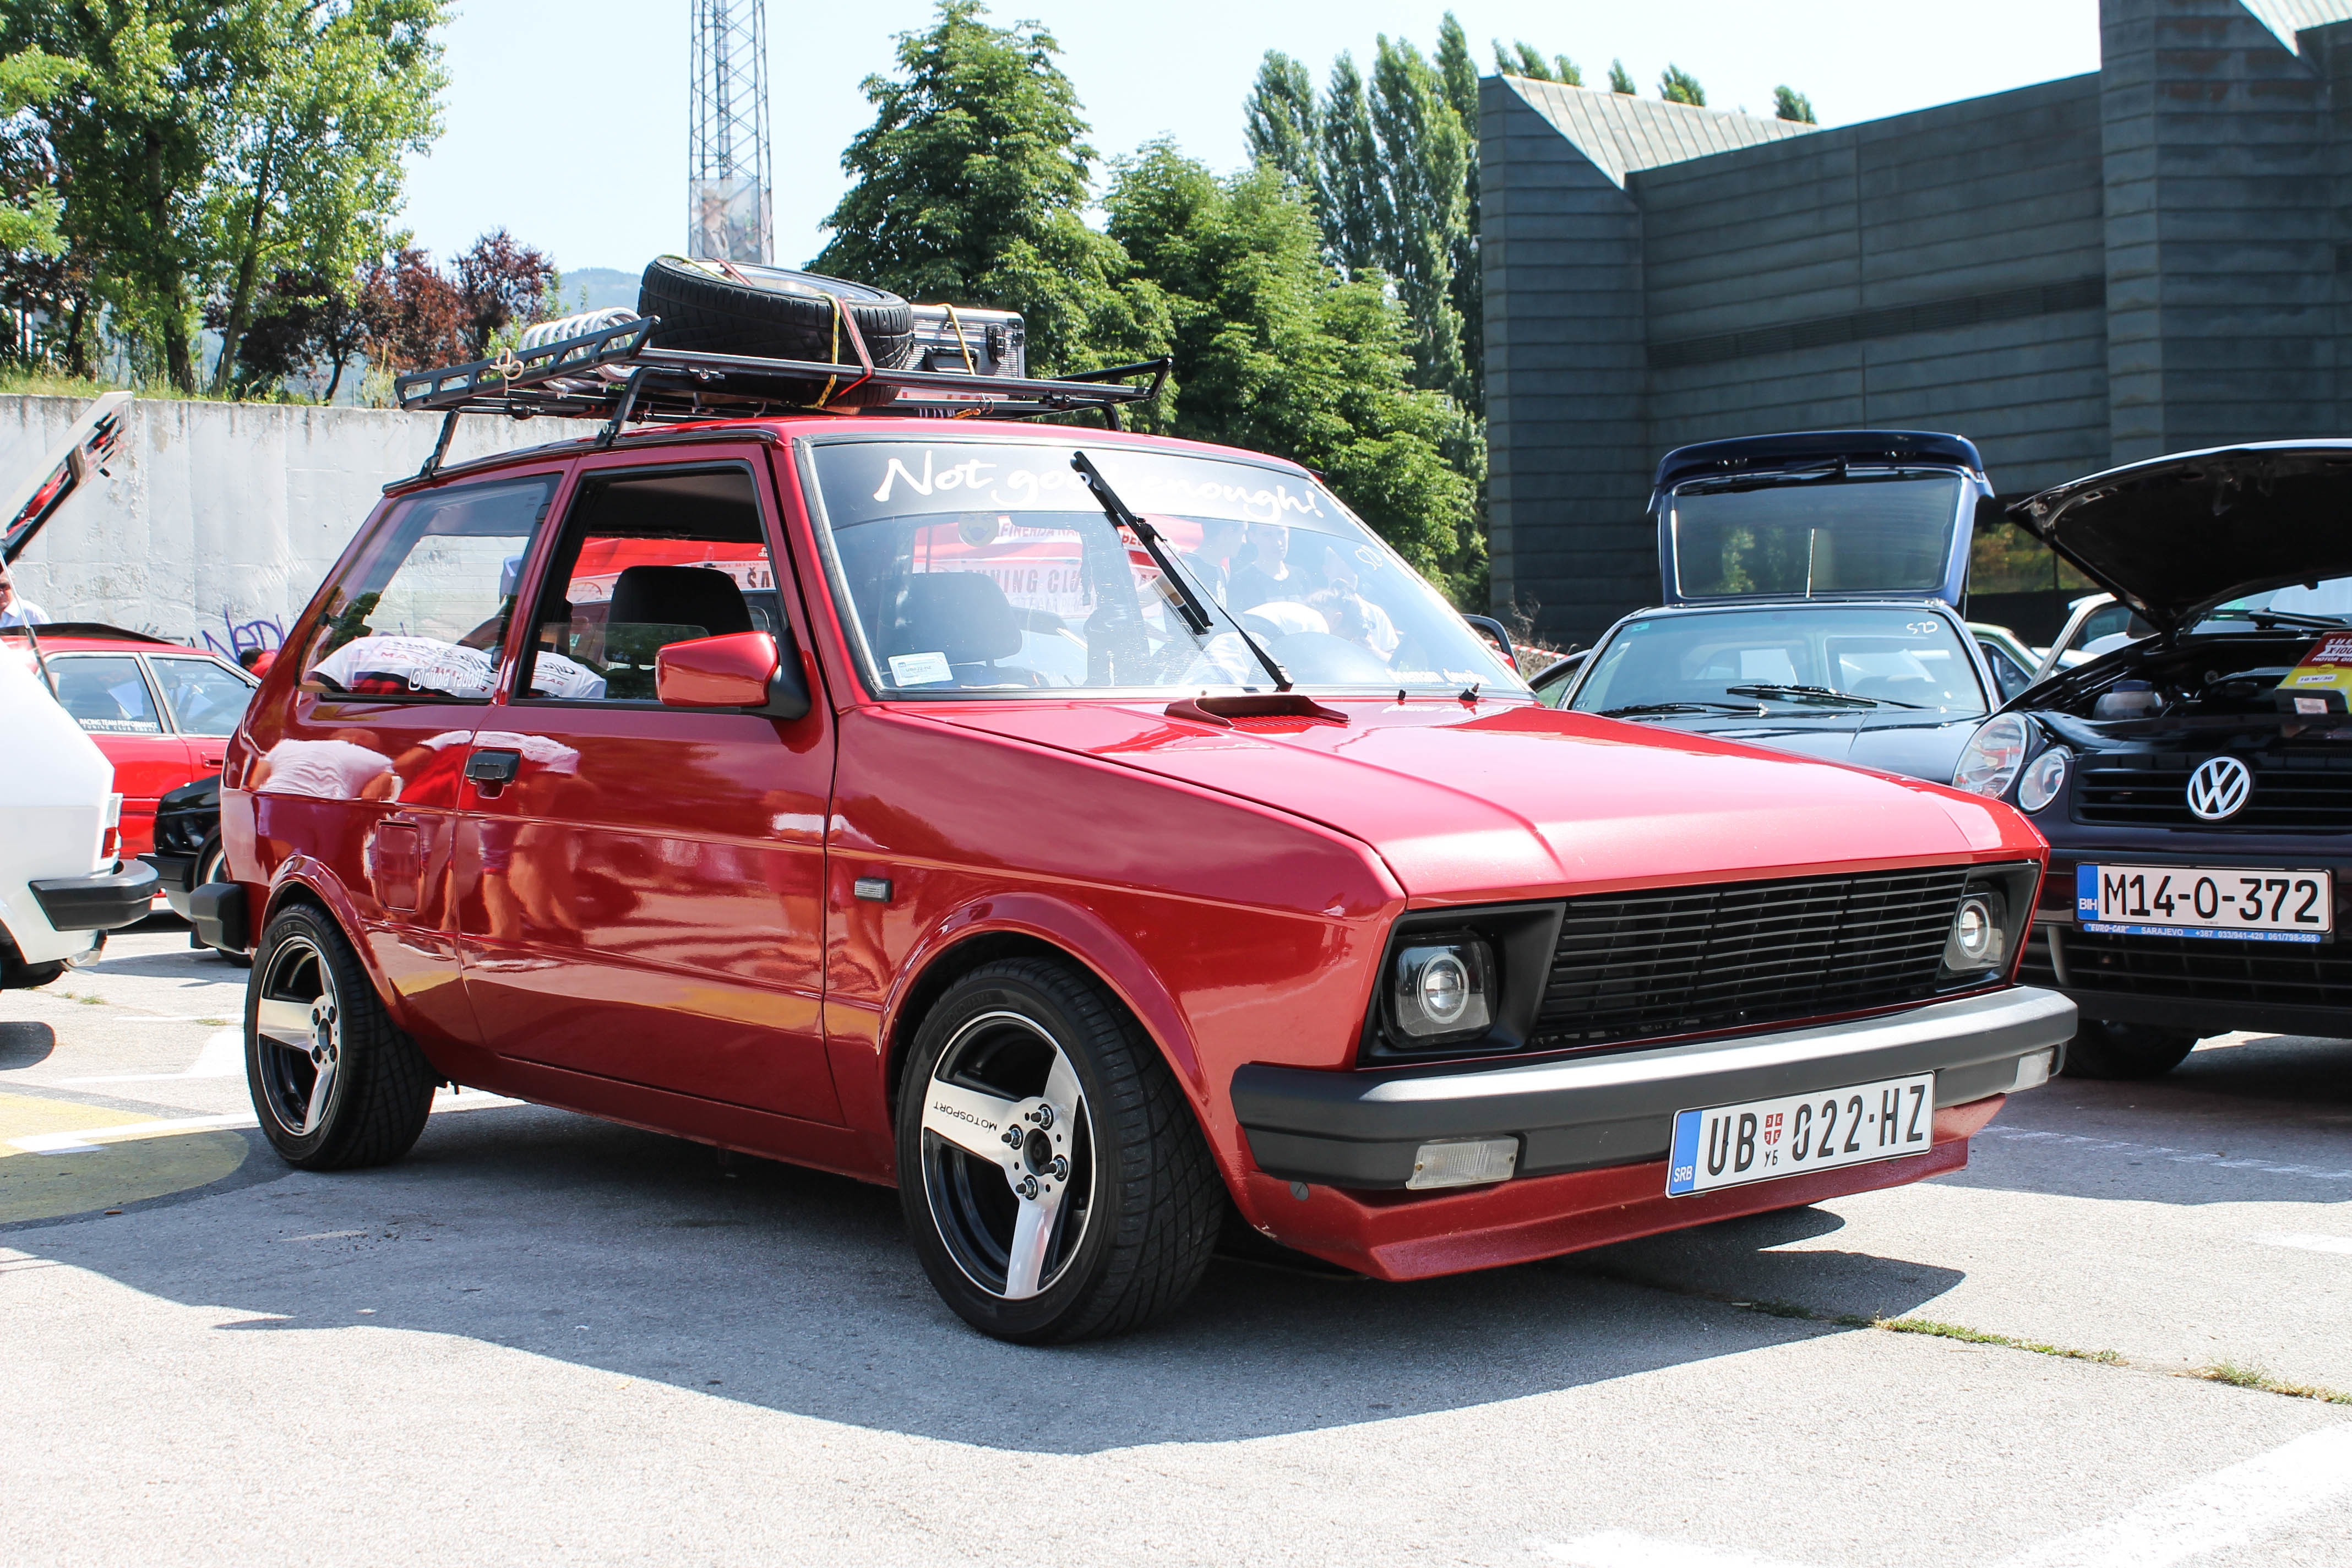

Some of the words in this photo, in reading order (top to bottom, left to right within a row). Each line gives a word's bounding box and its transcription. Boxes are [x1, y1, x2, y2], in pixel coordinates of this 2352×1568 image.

[873, 450, 997, 502] Not
[2078, 897, 2098, 911] BIH
[2141, 927, 2184, 936] SARAJEVO
[933, 1101, 998, 1132] MOTOSPORT
[1707, 1112, 1757, 1177] UB
[1673, 1166, 1694, 1183] SRB
